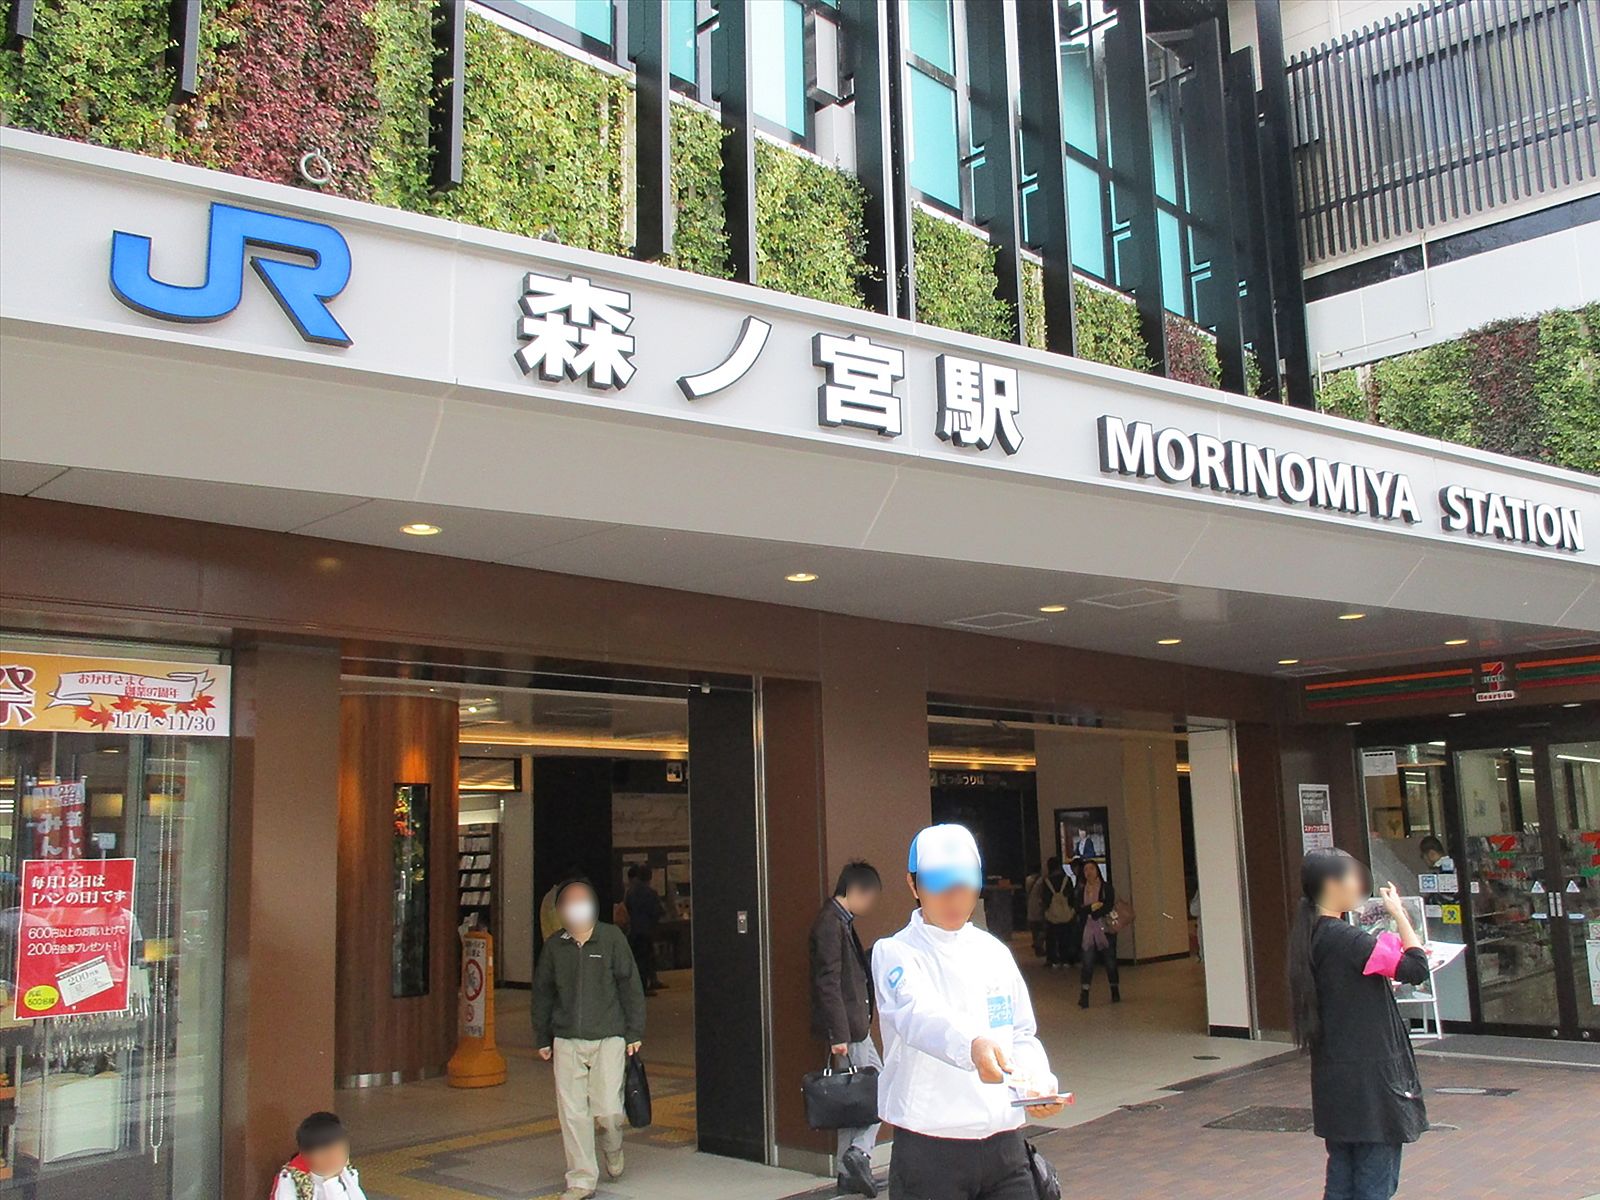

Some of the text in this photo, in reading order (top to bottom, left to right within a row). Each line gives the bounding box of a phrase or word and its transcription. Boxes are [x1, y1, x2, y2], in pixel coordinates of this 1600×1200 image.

[110, 201, 353, 347] JR
[514, 272, 1586, 552] 森ノ宮駅 MORINOMIYA STATION
[31, 875, 106, 890] 毎月12日は
